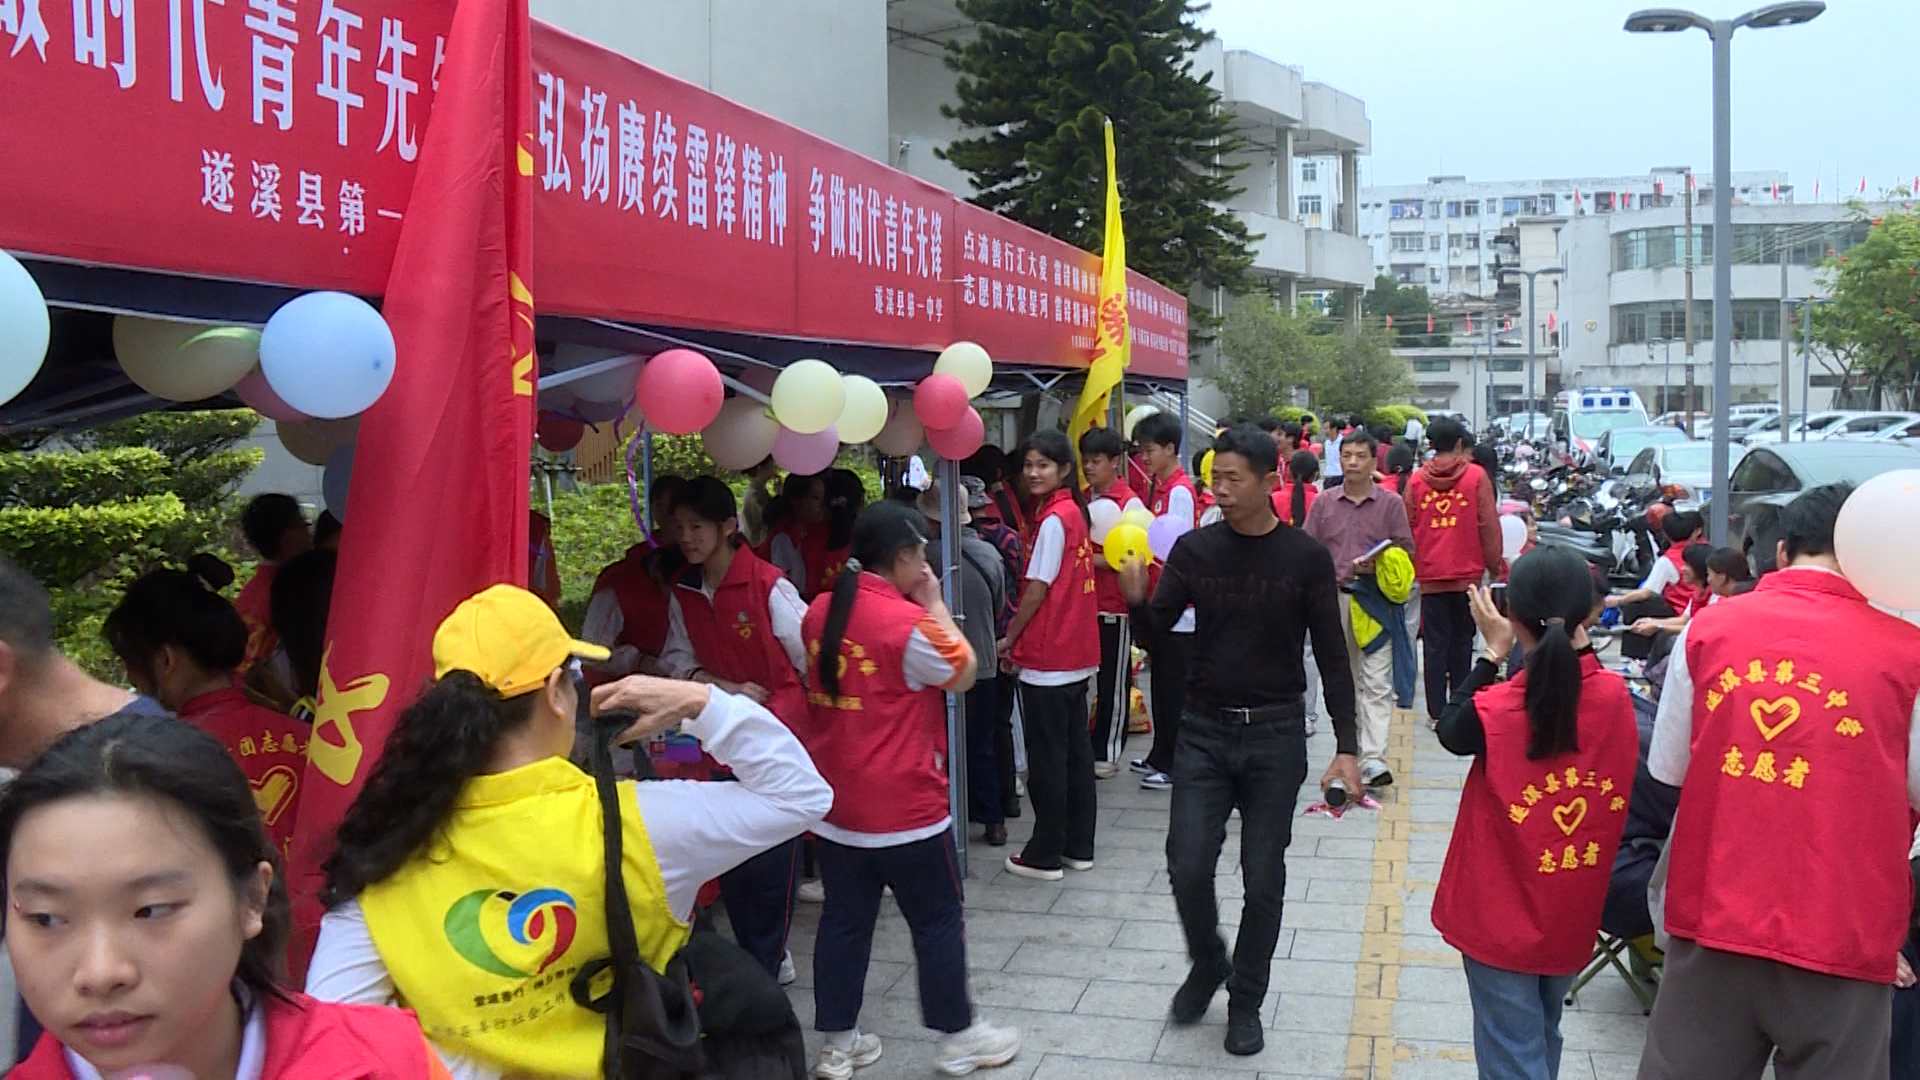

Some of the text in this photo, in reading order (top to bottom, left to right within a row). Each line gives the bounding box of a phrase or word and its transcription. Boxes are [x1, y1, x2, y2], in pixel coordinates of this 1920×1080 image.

[538, 72, 943, 281] 弘扬赓续雷锋精神 争做时代青年先锋
[963, 229, 1048, 282] 点滴善行汇大爱
[874, 285, 943, 323] 遂溪县第一中学
[1721, 745, 1810, 789] 志愿者
[1538, 841, 1600, 873] 志愿者
